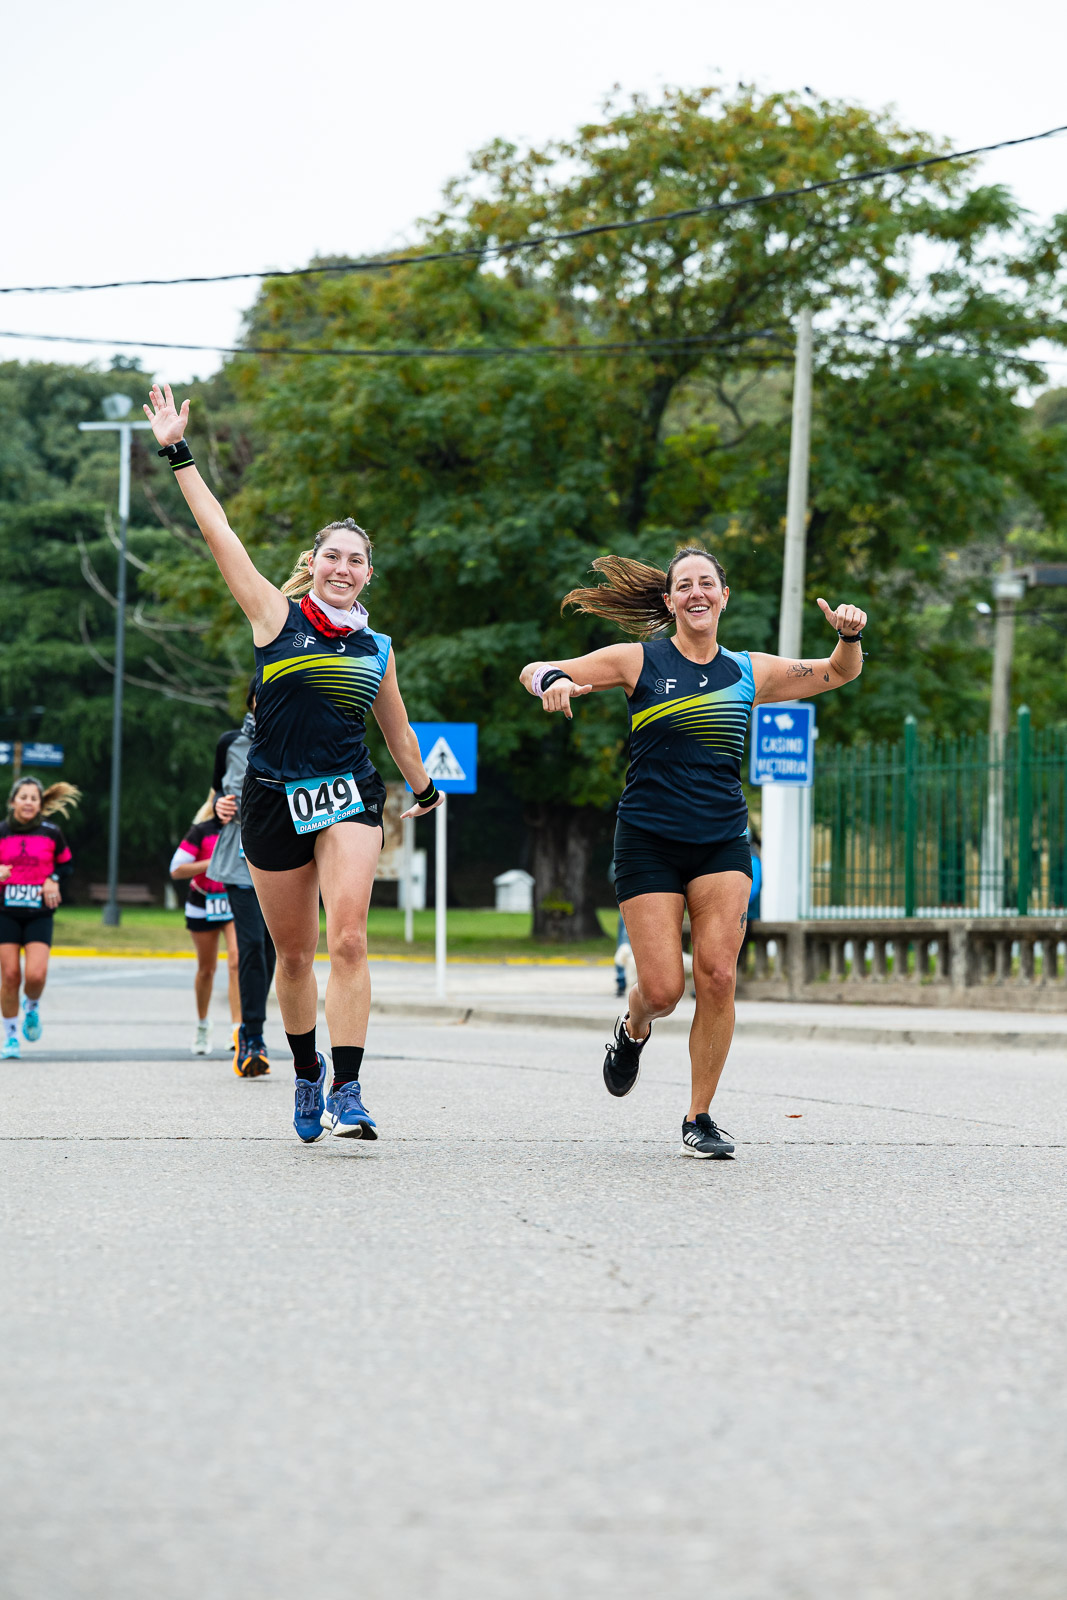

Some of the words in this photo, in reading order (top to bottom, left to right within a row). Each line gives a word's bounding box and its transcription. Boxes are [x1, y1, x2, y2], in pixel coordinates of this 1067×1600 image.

[293, 632, 317, 648] SF
[655, 678, 677, 694] SF
[761, 736, 804, 754] CASINO
[757, 758, 806, 774] VICTORIA
[292, 777, 353, 822] 049
[299, 816, 336, 833] DIAMANTE
[337, 806, 361, 820] CORRE
[9, 884, 38, 900] 090
